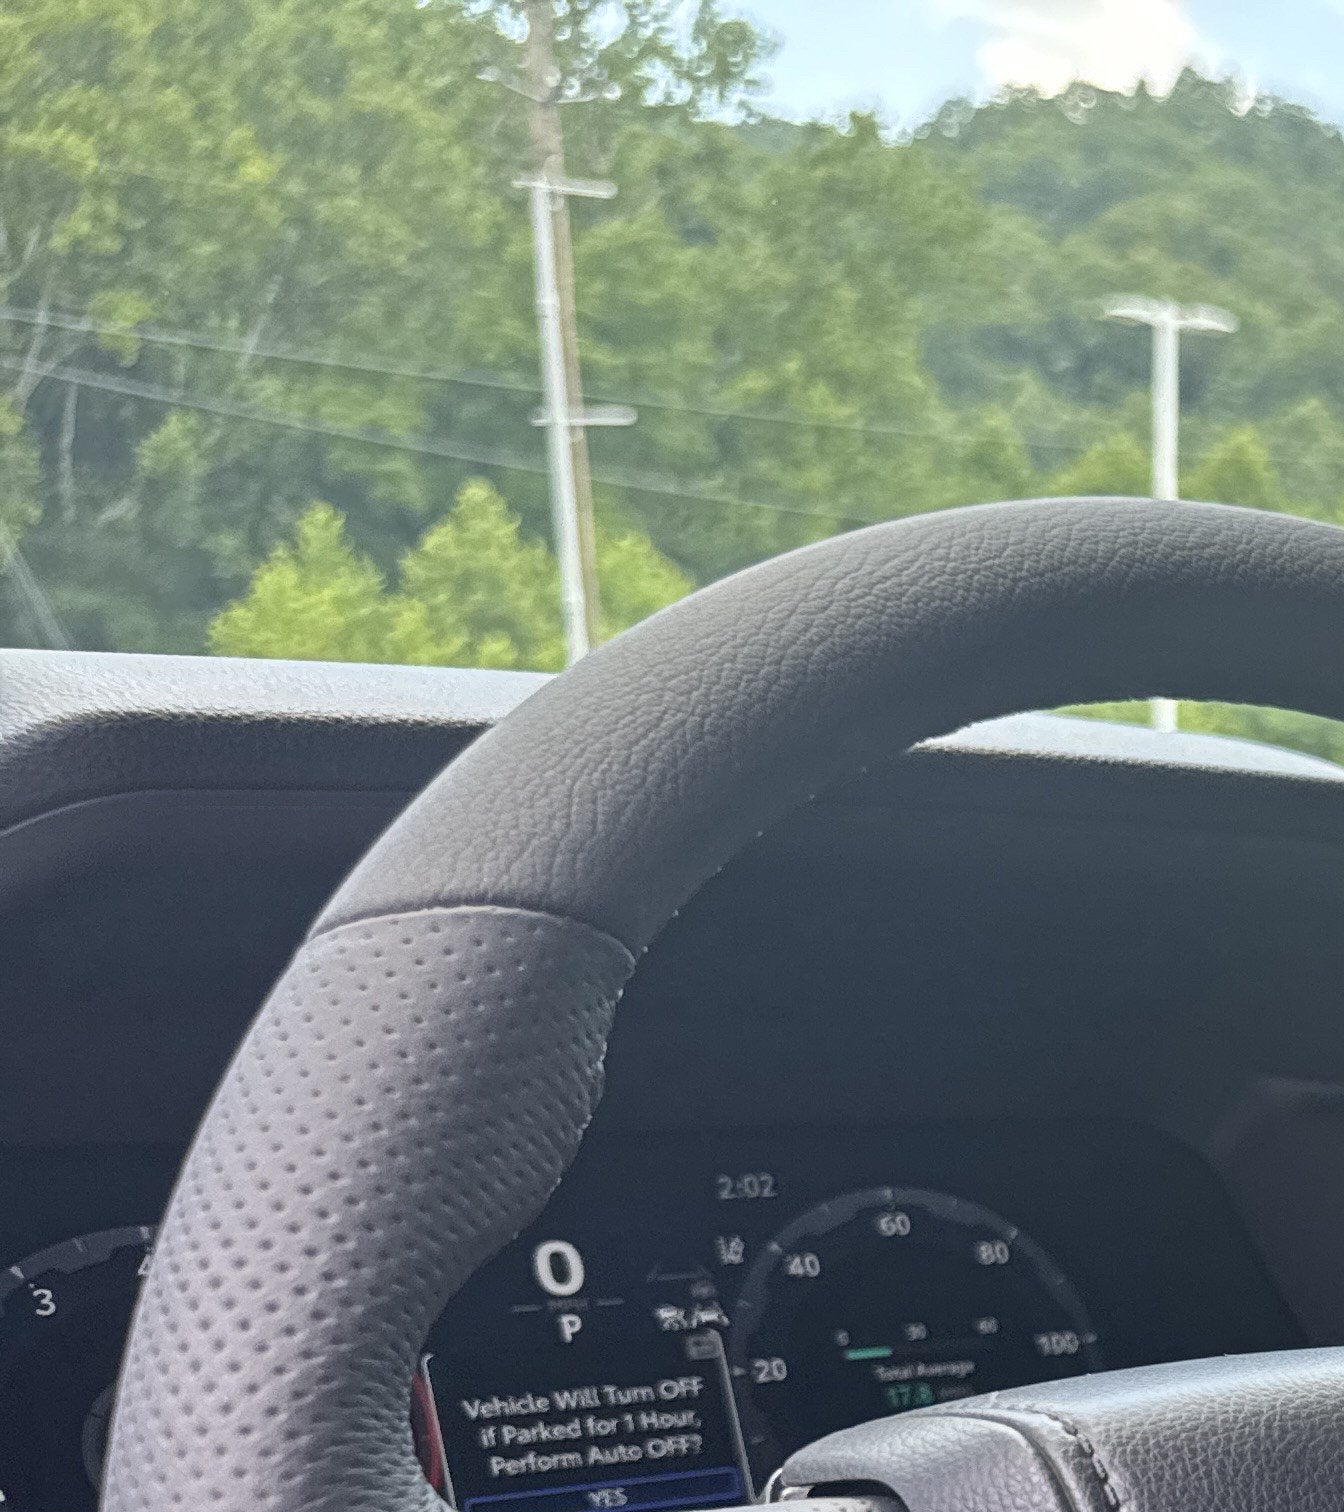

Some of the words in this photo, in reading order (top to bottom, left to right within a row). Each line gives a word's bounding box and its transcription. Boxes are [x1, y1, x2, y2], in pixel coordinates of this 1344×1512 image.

[877, 1211, 911, 1237] 60
[785, 1252, 820, 1277] 40
[976, 1240, 1010, 1265] 80
[533, 1240, 585, 1296] 0
[32, 1287, 57, 1316] 3
[559, 1314, 582, 1343] P
[752, 1357, 787, 1383] 20
[461, 1392, 549, 1420] Vehicle
[552, 1387, 600, 1411] Will
[602, 1384, 655, 1405] Turn
[657, 1376, 704, 1400] OFF
[500, 1417, 583, 1446] Parked
[585, 1416, 619, 1438] for
[490, 1450, 583, 1477] Perform
[586, 1443, 643, 1466] Auto
[588, 1488, 628, 1508] YES
